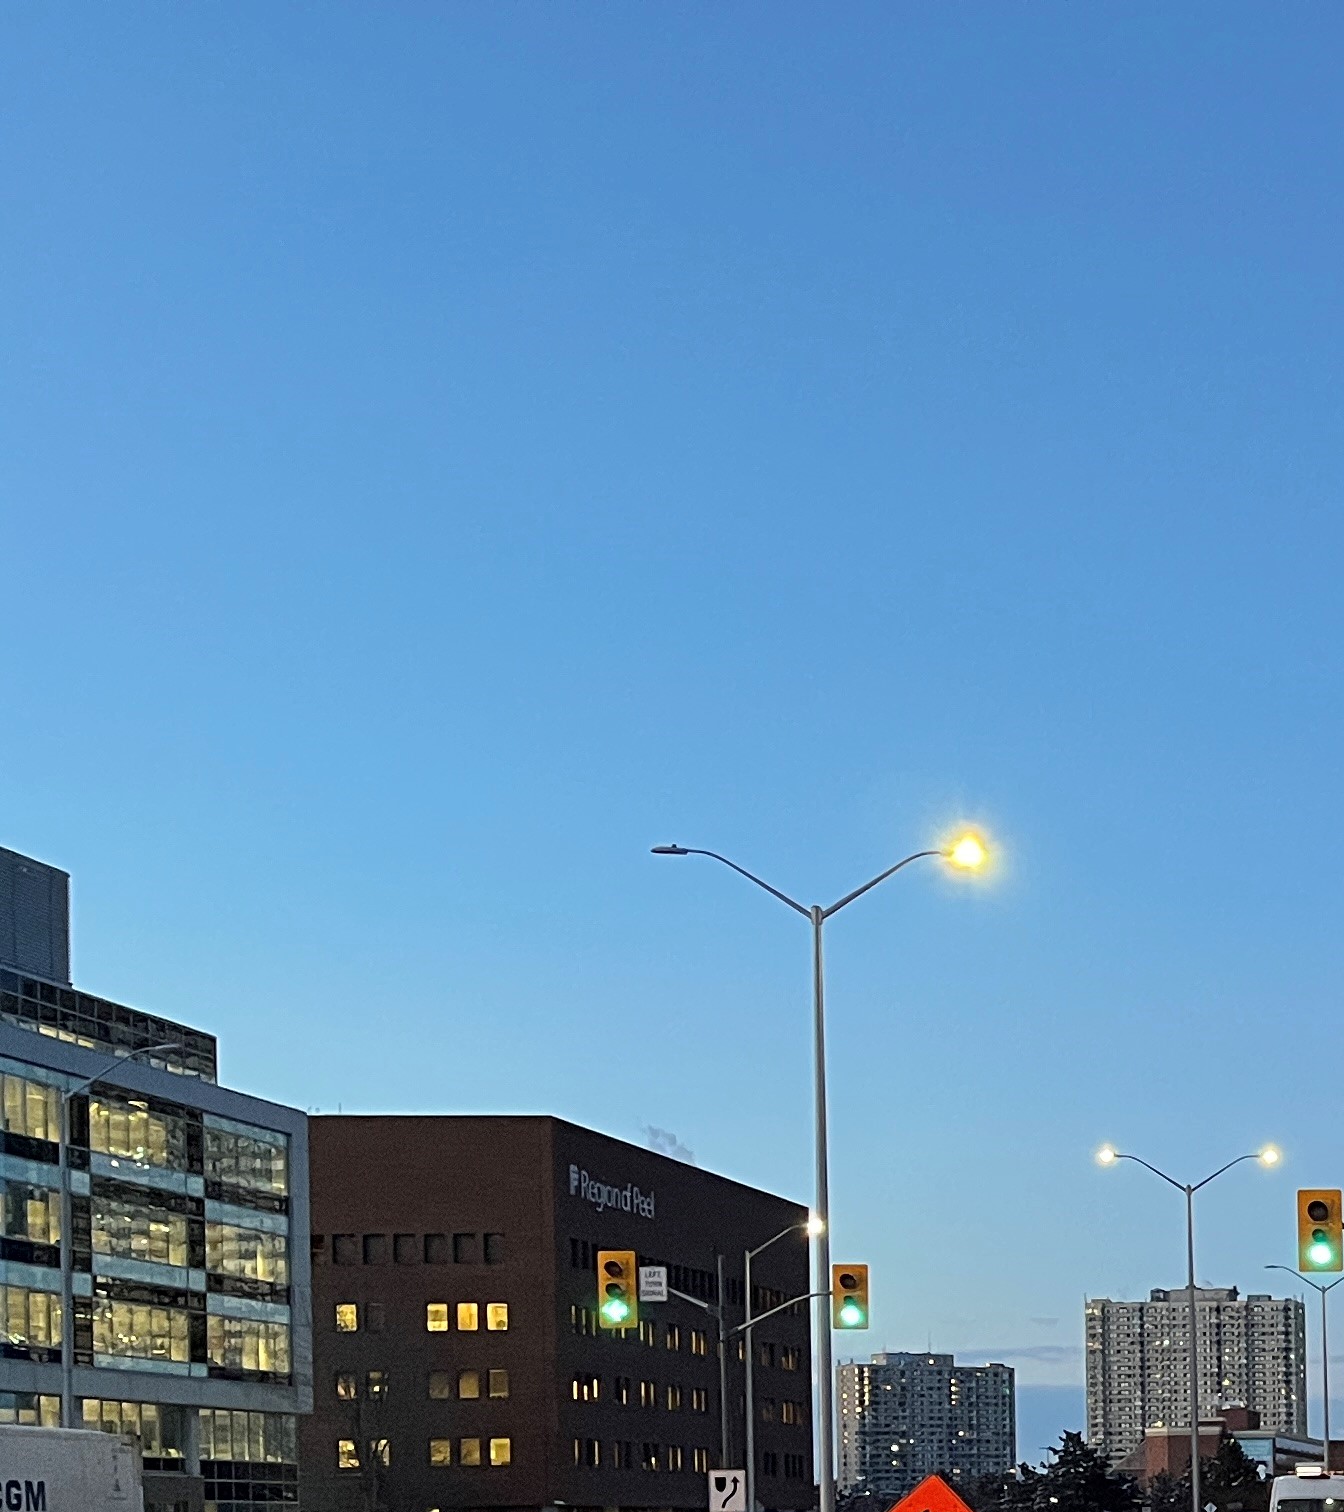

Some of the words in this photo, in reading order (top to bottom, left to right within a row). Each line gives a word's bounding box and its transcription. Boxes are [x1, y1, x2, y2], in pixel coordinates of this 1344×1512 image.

[581, 1170, 621, 1212] Region
[622, 1183, 632, 1212] of
[633, 1186, 655, 1219] Peel
[0, 1480, 46, 1511] GM
